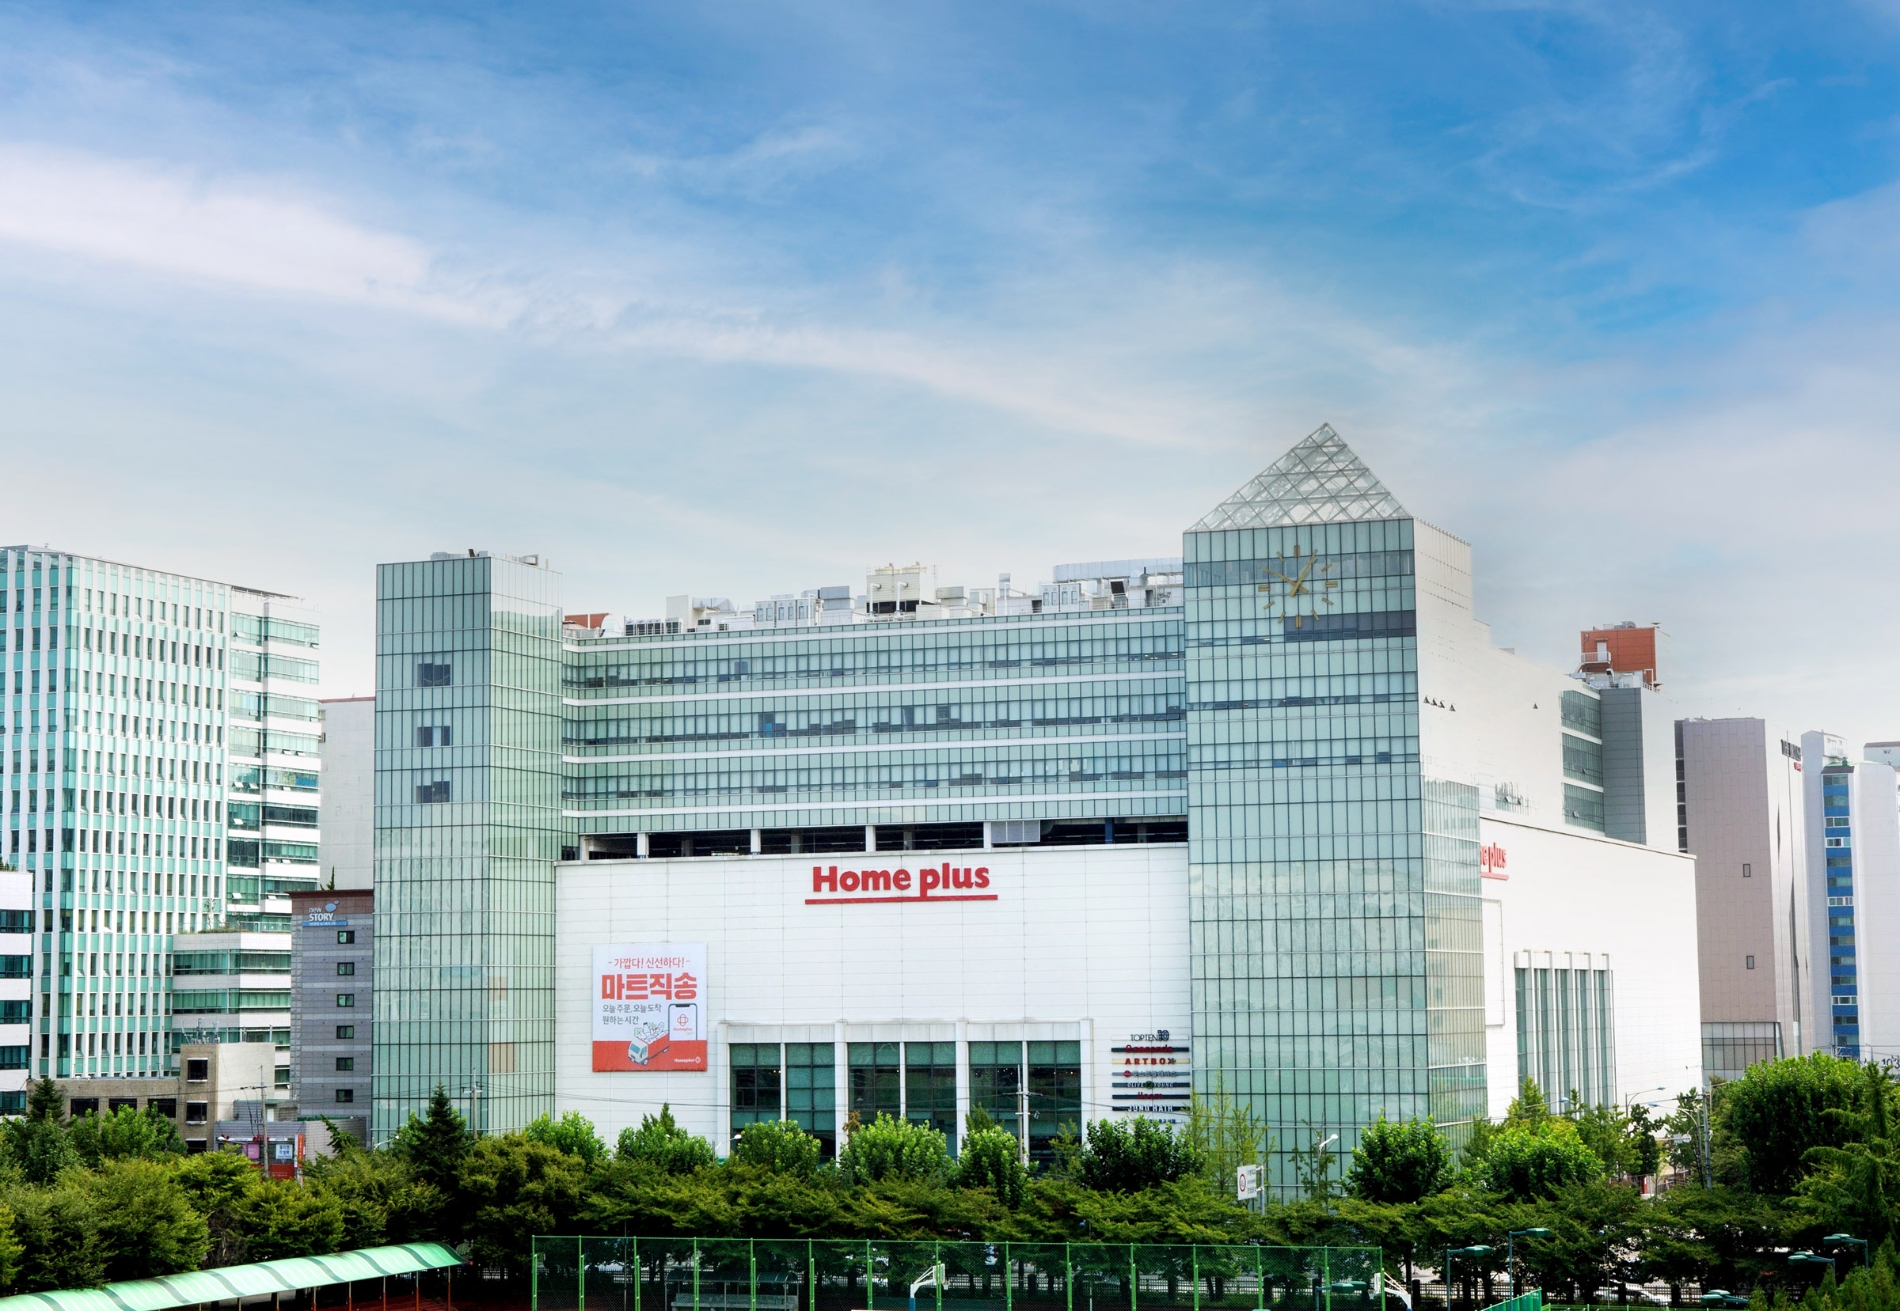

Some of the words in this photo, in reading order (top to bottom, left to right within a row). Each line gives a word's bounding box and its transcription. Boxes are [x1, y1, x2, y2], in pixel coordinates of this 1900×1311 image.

[1488, 842, 1506, 872] plus
[813, 866, 911, 892] Home
[920, 862, 990, 898] plus
[309, 913, 333, 921] STORY
[614, 957, 644, 969] 가깝다!
[645, 956, 685, 969] 신선하다!
[601, 972, 697, 1000] 마트직송
